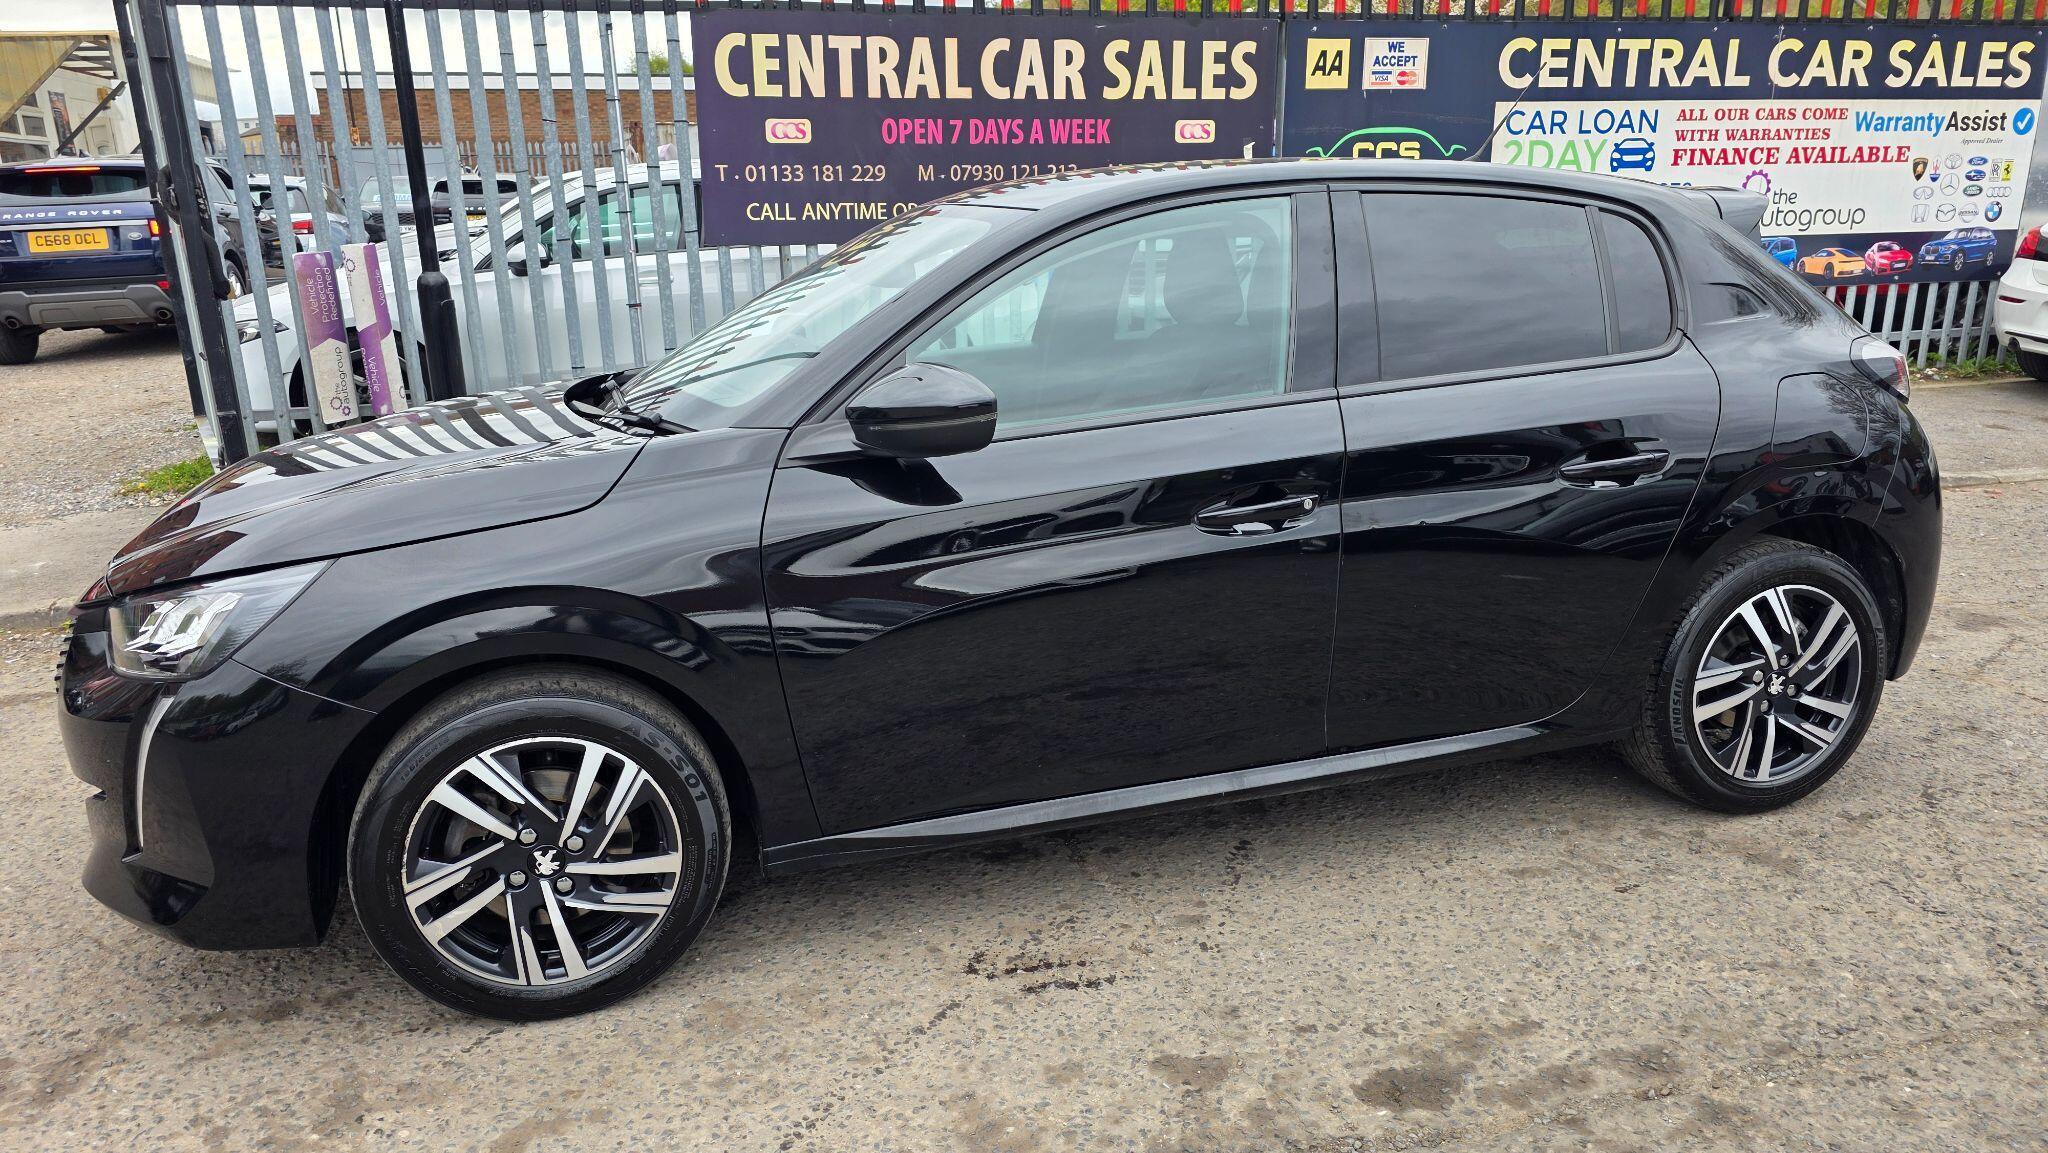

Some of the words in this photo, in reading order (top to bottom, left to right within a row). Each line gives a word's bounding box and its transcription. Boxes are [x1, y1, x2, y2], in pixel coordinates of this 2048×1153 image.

[1388, 41, 1405, 53] WE
[714, 32, 973, 99] CENTRAL
[980, 37, 1087, 100] CAR
[1102, 39, 1258, 100] SALES
[1311, 50, 1344, 76] AA
[1373, 56, 1418, 67] ACCEPT
[1499, 37, 1751, 89] CENTRAL
[1768, 38, 1873, 88] CAR
[1884, 39, 2036, 88] SALES
[1505, 109, 1568, 135] CAR
[1578, 108, 1659, 135] LOAN
[1676, 108, 1708, 121] ALL
[1714, 108, 1750, 121] OUR
[1755, 108, 1797, 120] CARS
[1802, 107, 1848, 120] COME
[881, 117, 943, 145] OPEN
[949, 118, 963, 145] 7
[969, 118, 1024, 145] DAYS
[1029, 118, 1044, 145] A
[1049, 118, 1112, 145] WEEK
[1675, 129, 1719, 142] WITH
[1725, 128, 1831, 141] WARRANTIES
[1503, 138, 1608, 172] 2DAY
[1671, 147, 1780, 166] FINANCE
[1786, 146, 1910, 165] AVAILABLE
[745, 164, 804, 182] 01133
[812, 164, 844, 182] 181
[850, 164, 886, 182] 229
[950, 164, 1004, 182] 07930
[1011, 164, 1039, 179] 121
[1773, 188, 1798, 204] the
[3, 211, 57, 219] RANGE
[746, 203, 796, 220] CALL
[802, 203, 888, 220] ANYTIME
[1760, 207, 1866, 231] utogroup
[35, 234, 71, 247] CE68
[75, 233, 101, 245] OCL
[306, 278, 319, 315] Vehicle
[314, 267, 330, 322] Protection
[325, 267, 338, 320] Redefined
[375, 269, 386, 306] Vehicle
[334, 346, 349, 405] autogroup
[368, 356, 380, 392] Vehicle
[1673, 678, 1688, 744] LANDSAIL
